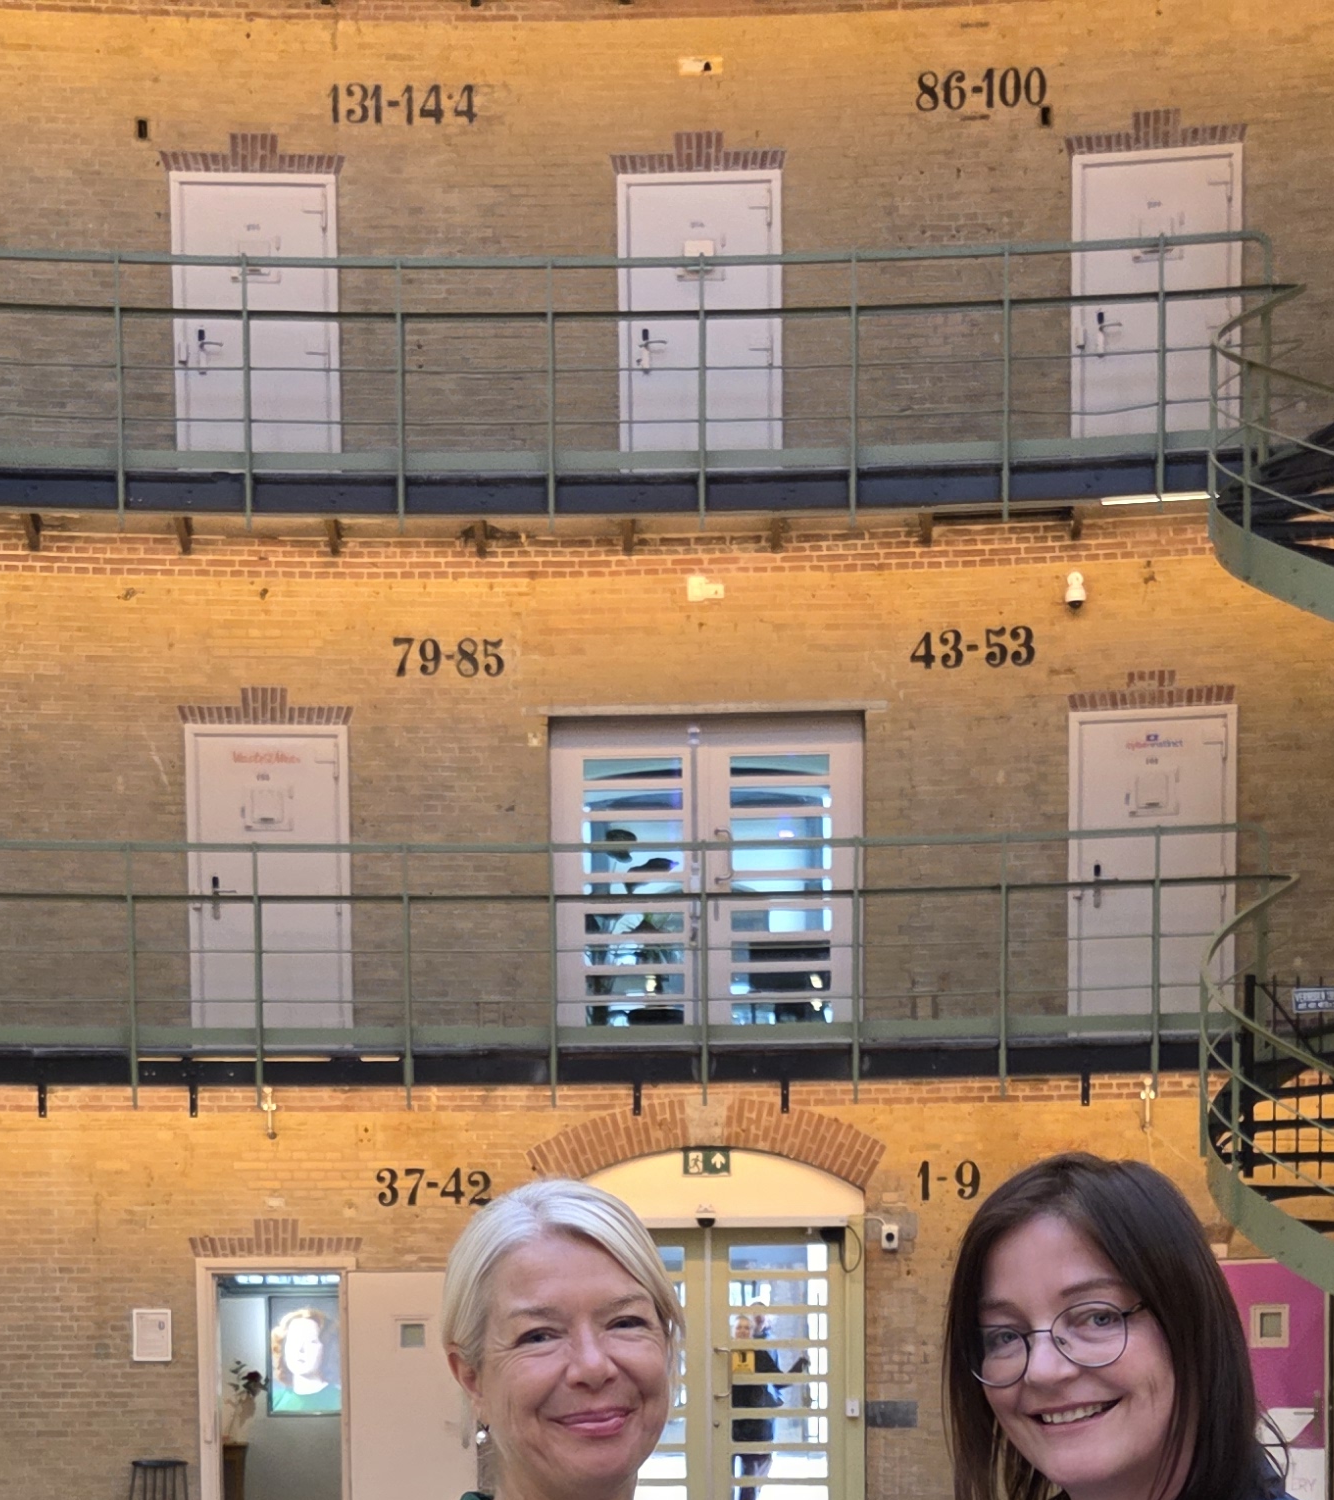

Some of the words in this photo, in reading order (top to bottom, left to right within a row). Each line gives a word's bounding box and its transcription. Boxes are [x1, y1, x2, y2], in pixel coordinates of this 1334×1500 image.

[328, 83, 478, 125] 131-144
[916, 67, 1047, 111] 86-100
[392, 637, 505, 678] 79-85
[910, 625, 1035, 669] 43-53
[376, 1167, 493, 1207] 37-42
[917, 1160, 981, 1201] 1-9
